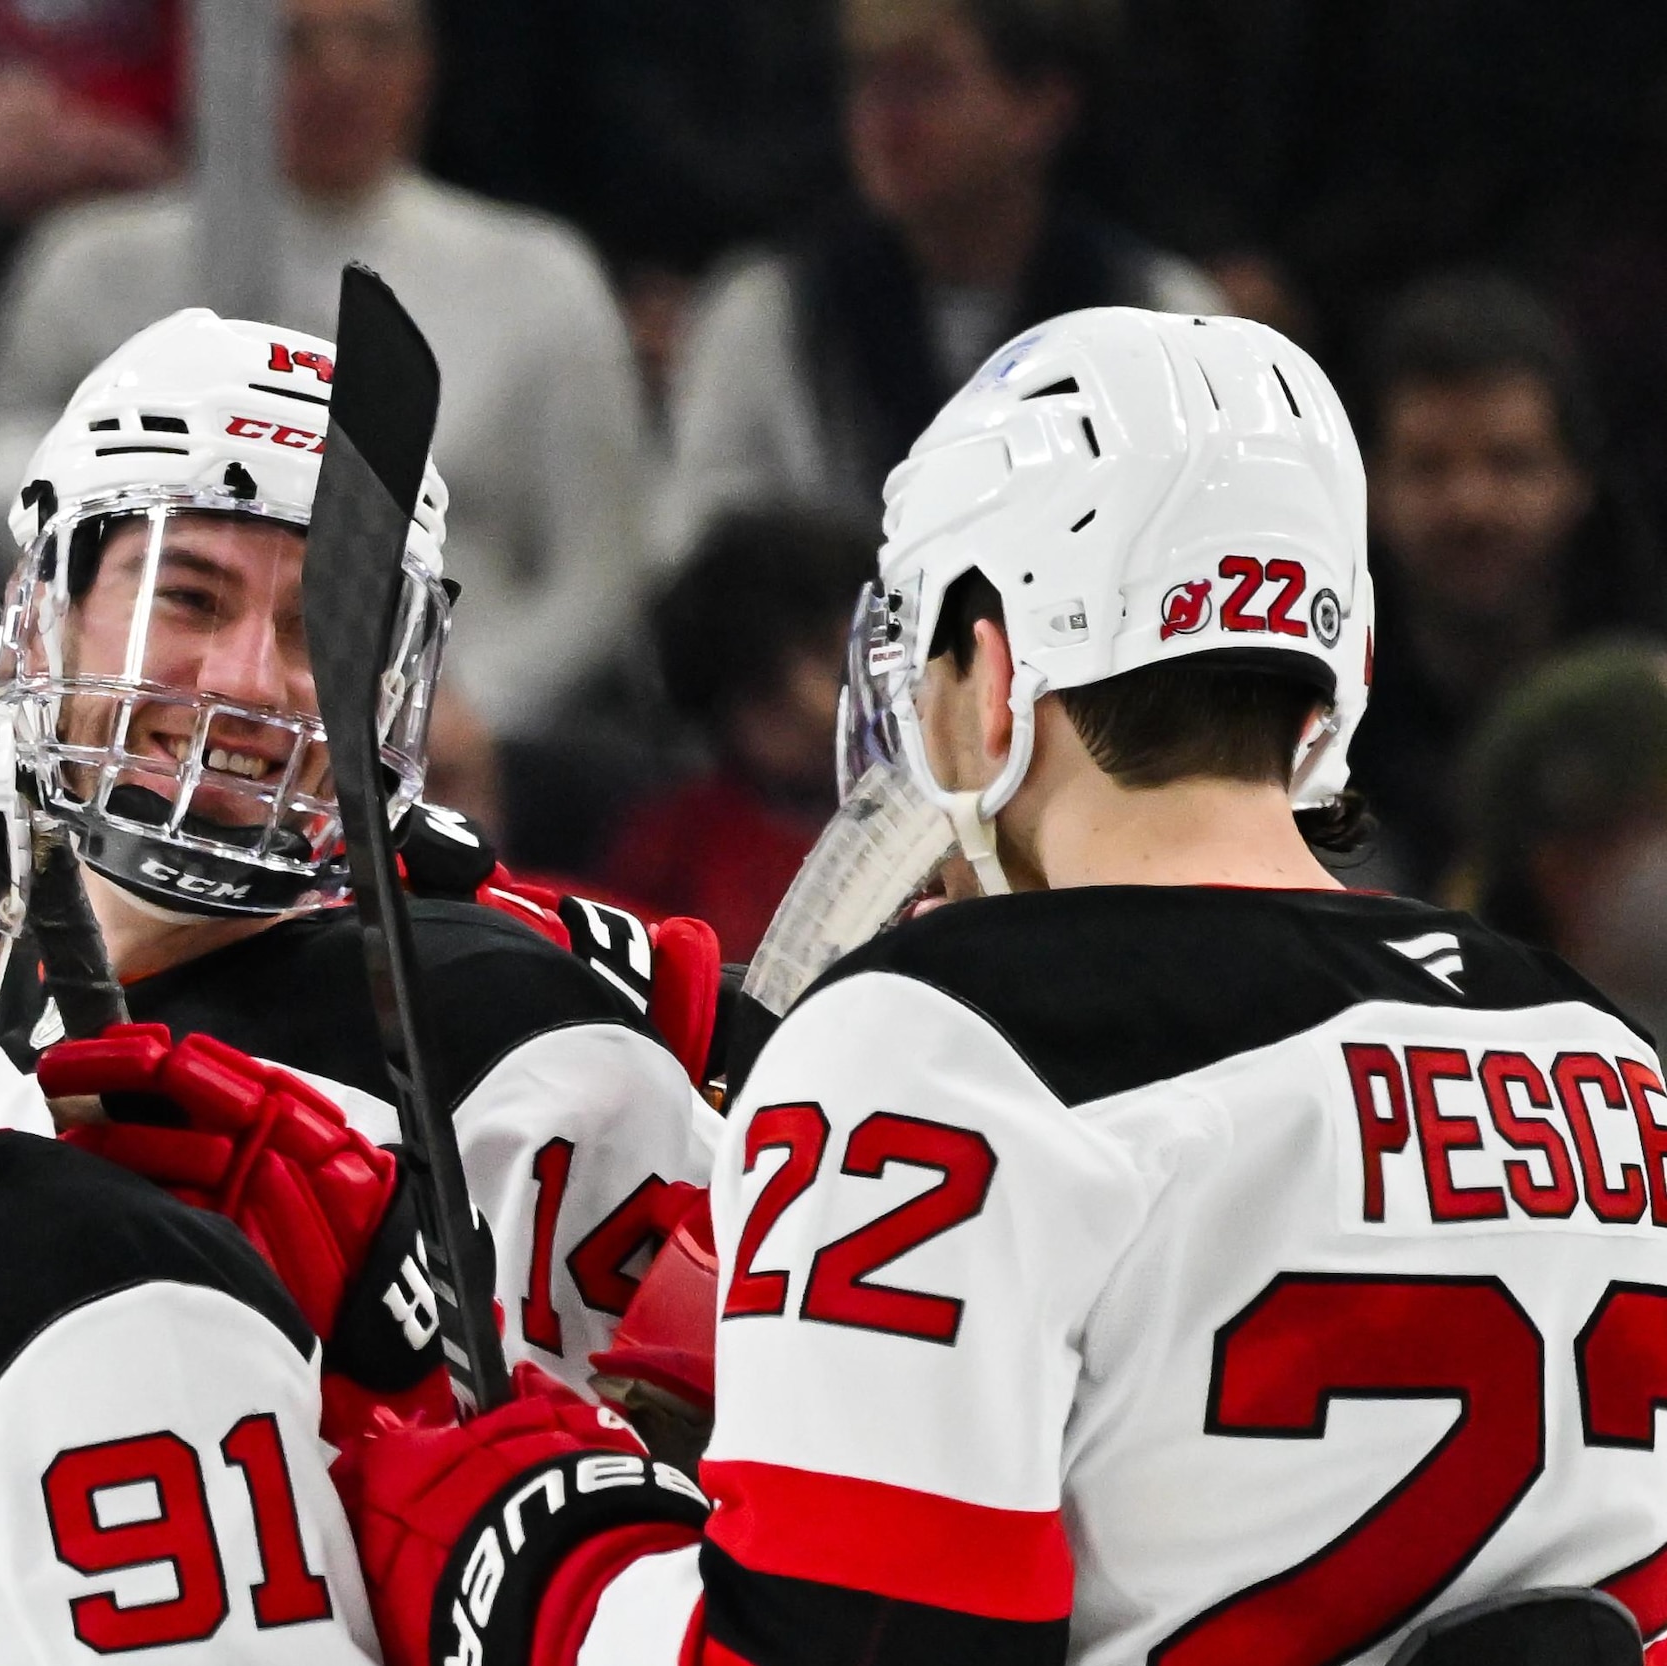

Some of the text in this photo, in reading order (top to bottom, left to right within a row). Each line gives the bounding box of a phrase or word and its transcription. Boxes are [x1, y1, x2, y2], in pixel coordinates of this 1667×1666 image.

[226, 416, 327, 454] CC
[1218, 555, 1308, 637] 22
[140, 857, 252, 900] CCM
[720, 1101, 997, 1348] 22
[42, 1412, 333, 1654] 91
